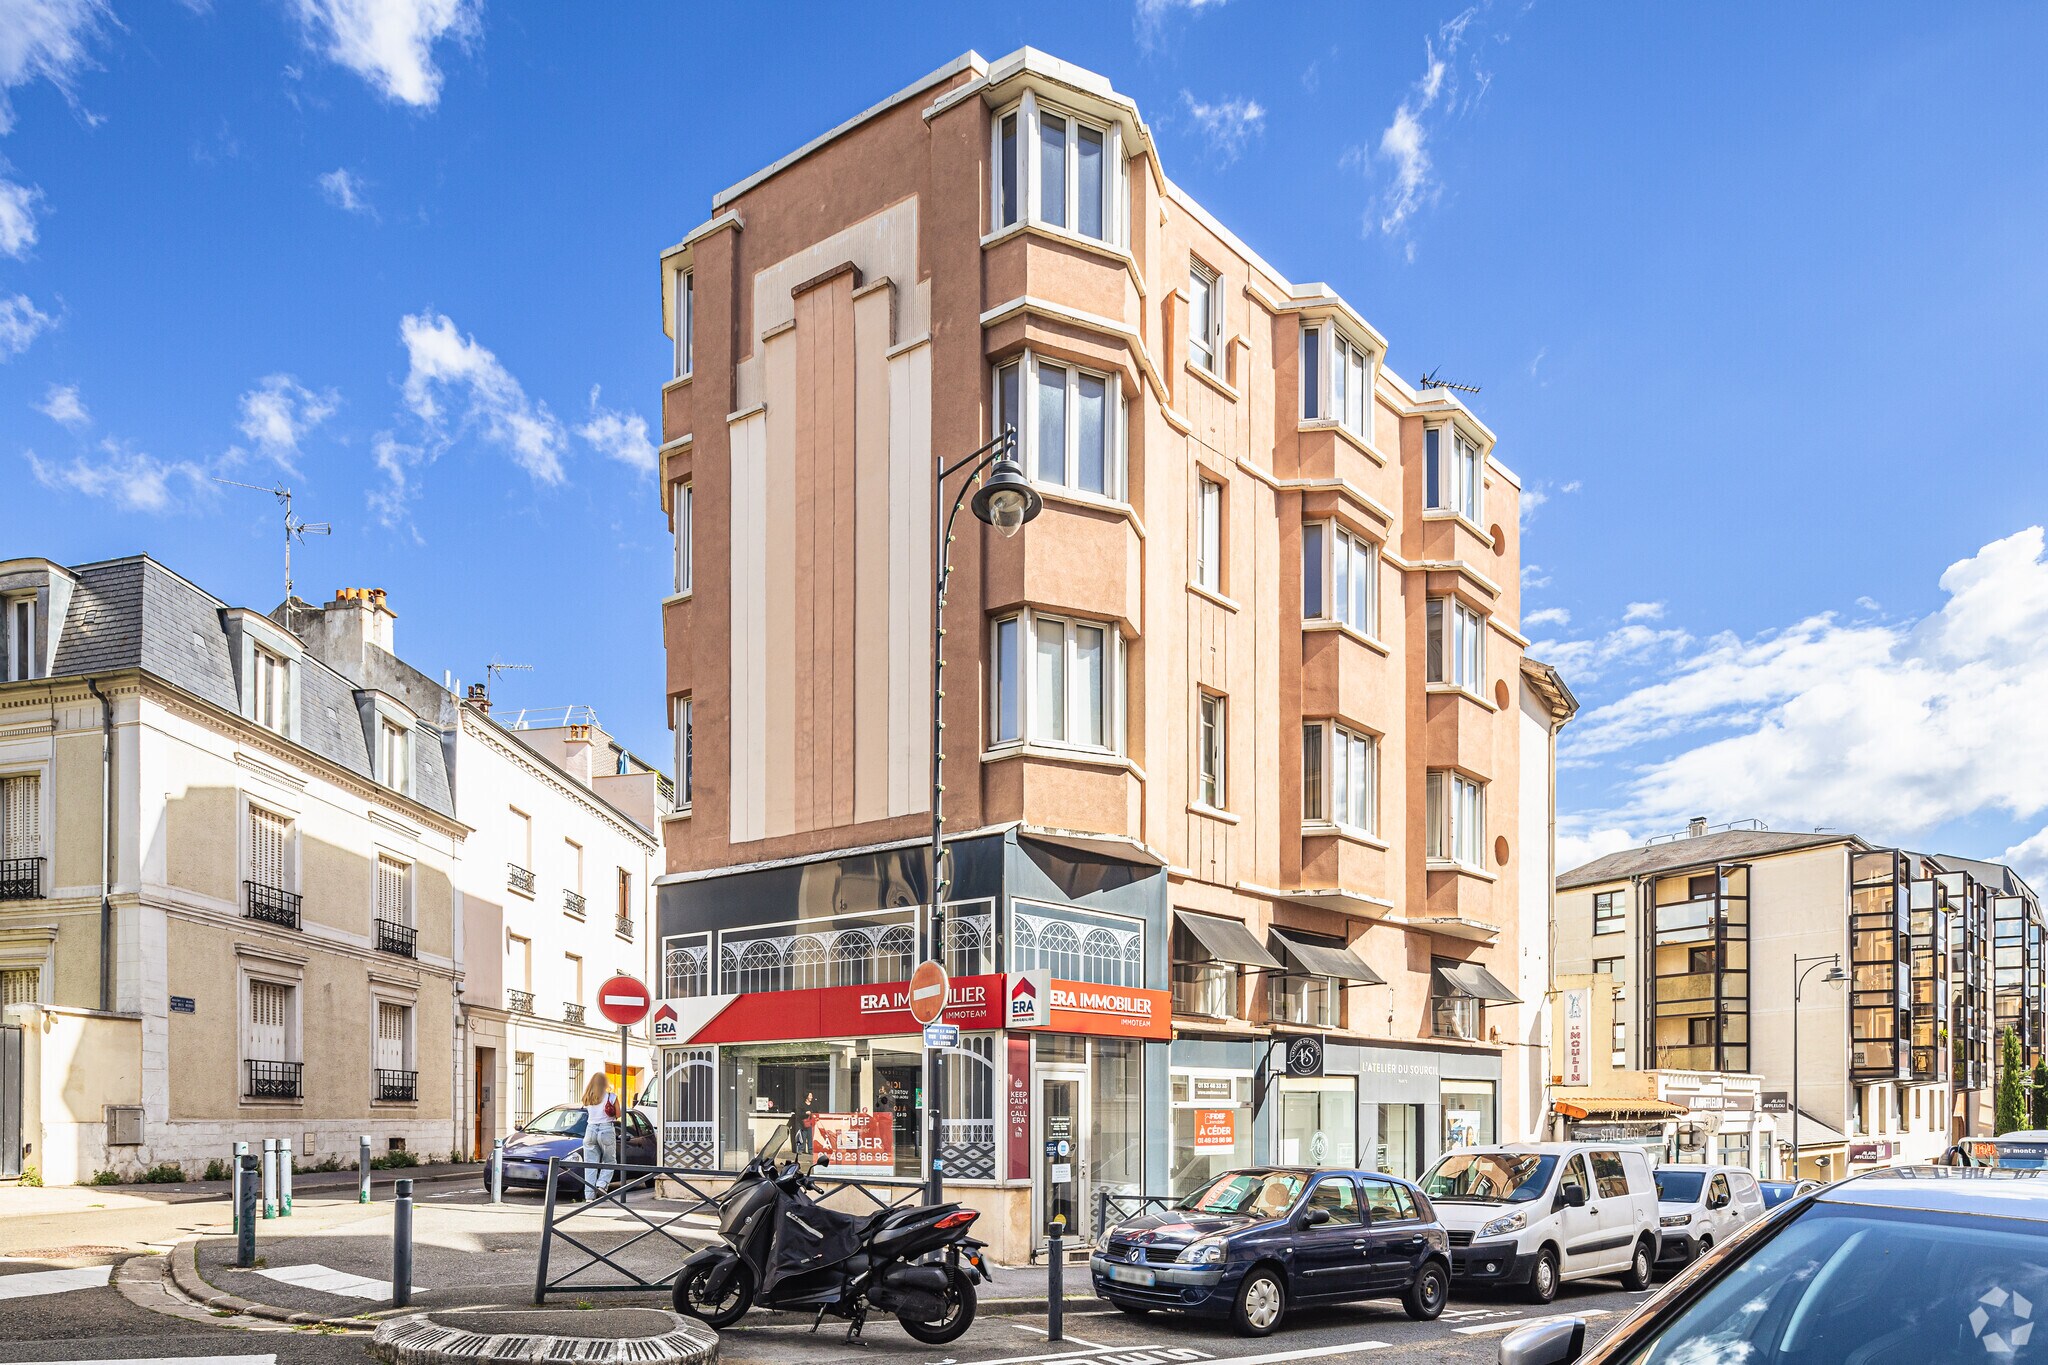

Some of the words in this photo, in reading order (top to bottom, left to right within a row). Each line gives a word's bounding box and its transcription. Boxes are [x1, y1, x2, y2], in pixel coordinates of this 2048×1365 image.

[861, 994, 890, 1009] ERA
[894, 986, 986, 1007] IMILIER
[1050, 989, 1077, 1006] ERA
[1080, 993, 1151, 1014] IMMOBILIER
[1012, 1000, 1034, 1013] ERA
[946, 1010, 987, 1019] IMMOTEAM
[655, 1023, 676, 1033] ERA
[1121, 1019, 1151, 1027] IMMOTEAM
[1570, 1032, 1581, 1081] MOULIN
[1362, 1062, 1397, 1074] L'ATELIER
[1398, 1064, 1409, 1074] DU
[1410, 1065, 1439, 1076] SOURCIL
[1200, 1124, 1206, 1136] À
[1207, 1124, 1231, 1135] CÉDER
[1600, 1128, 1620, 1141] STYLE
[1622, 1127, 1639, 1140] DECO
[830, 1152, 843, 1161] 49
[844, 1152, 857, 1161] 23
[859, 1152, 873, 1162] 86
[875, 1152, 889, 1162] 96
